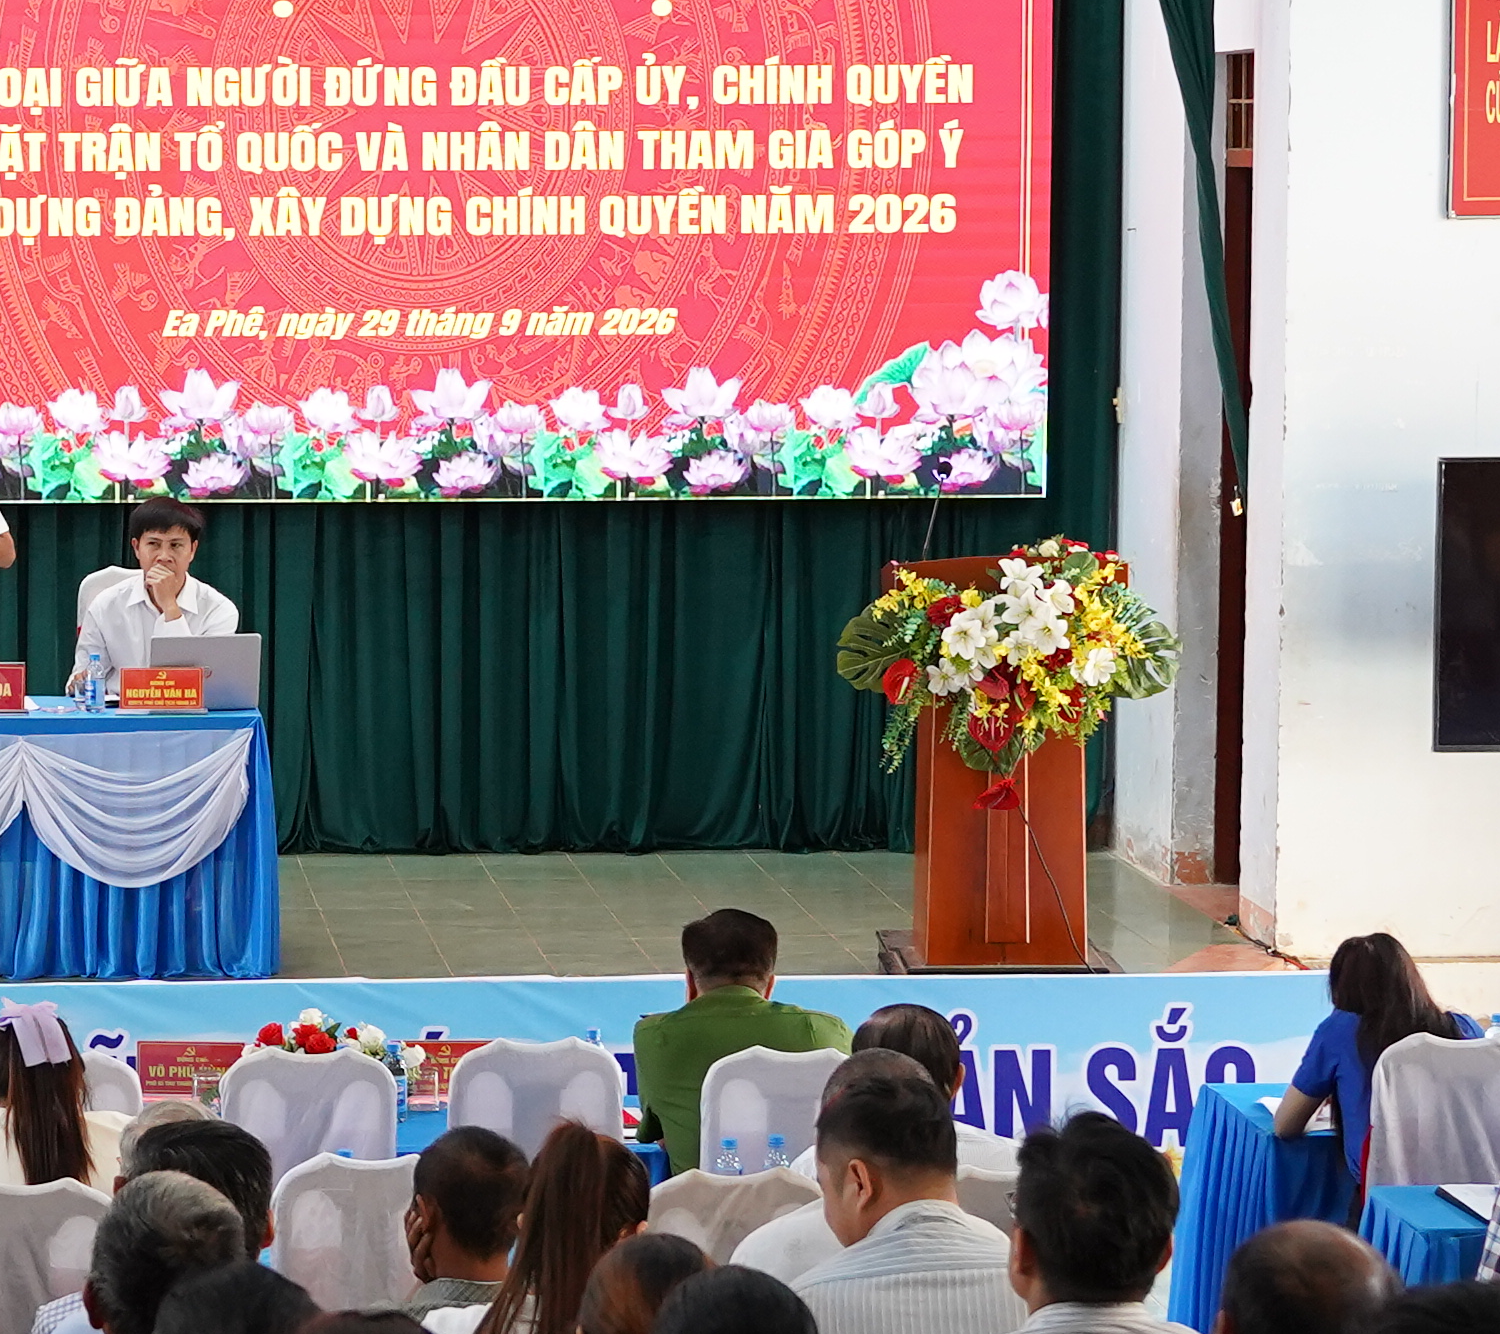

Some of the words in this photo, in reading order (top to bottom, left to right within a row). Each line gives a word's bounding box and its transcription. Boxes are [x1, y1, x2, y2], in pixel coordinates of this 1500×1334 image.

[76, 59, 172, 107] GIỮA
[187, 57, 310, 107] NGƯỜI
[324, 57, 436, 107] ĐỨNG
[450, 57, 530, 106] ĐẦU
[544, 57, 622, 106] CẤP
[636, 53, 699, 110] ỦY,
[713, 51, 832, 105] CHÍNH
[845, 56, 973, 107] QUYỀN
[59, 123, 161, 180] TRẬN
[175, 121, 223, 172] TỔ
[236, 123, 343, 174] QUỐC
[356, 122, 408, 172] VÀ
[422, 121, 531, 171] NHÂN
[545, 121, 625, 170] DÂN
[637, 130, 754, 170] THAM
[768, 130, 833, 169] GIA
[846, 120, 927, 168] GÓP
[939, 120, 963, 168] Ý
[114, 184, 235, 241] ĐẢNG,
[248, 187, 326, 237] XÂY
[340, 196, 452, 245] DỰNG
[466, 186, 585, 236] CHÍNH
[599, 186, 726, 237] QUYỀN
[740, 186, 833, 234] NĂM
[849, 194, 957, 233] 2026
[163, 310, 196, 337] Ea
[204, 307, 268, 339] Phê,
[277, 310, 353, 340] ngày
[359, 309, 397, 336] 29
[406, 307, 492, 339] tháng
[500, 308, 523, 336] 9
[526, 309, 593, 336] năm
[599, 307, 678, 336] 2026
[126, 687, 161, 698] NGUYỄN
[952, 1014, 1051, 1139] ẢN
